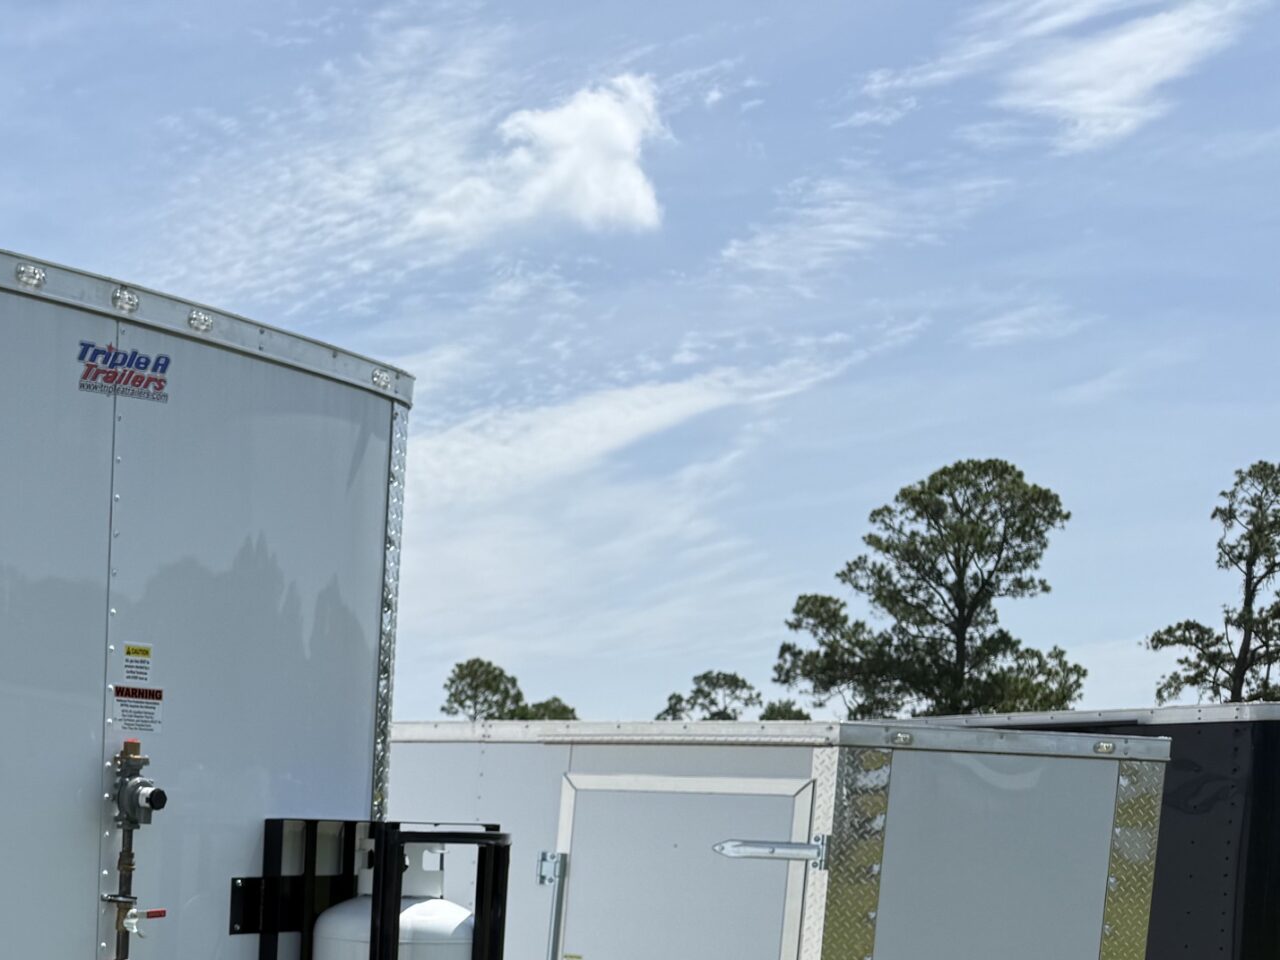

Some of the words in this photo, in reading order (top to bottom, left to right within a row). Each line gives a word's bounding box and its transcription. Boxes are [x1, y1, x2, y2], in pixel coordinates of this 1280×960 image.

[78, 342, 151, 370] Triple
[151, 355, 170, 374] A
[81, 363, 167, 391] Trailers
[115, 686, 163, 700] WARNING
